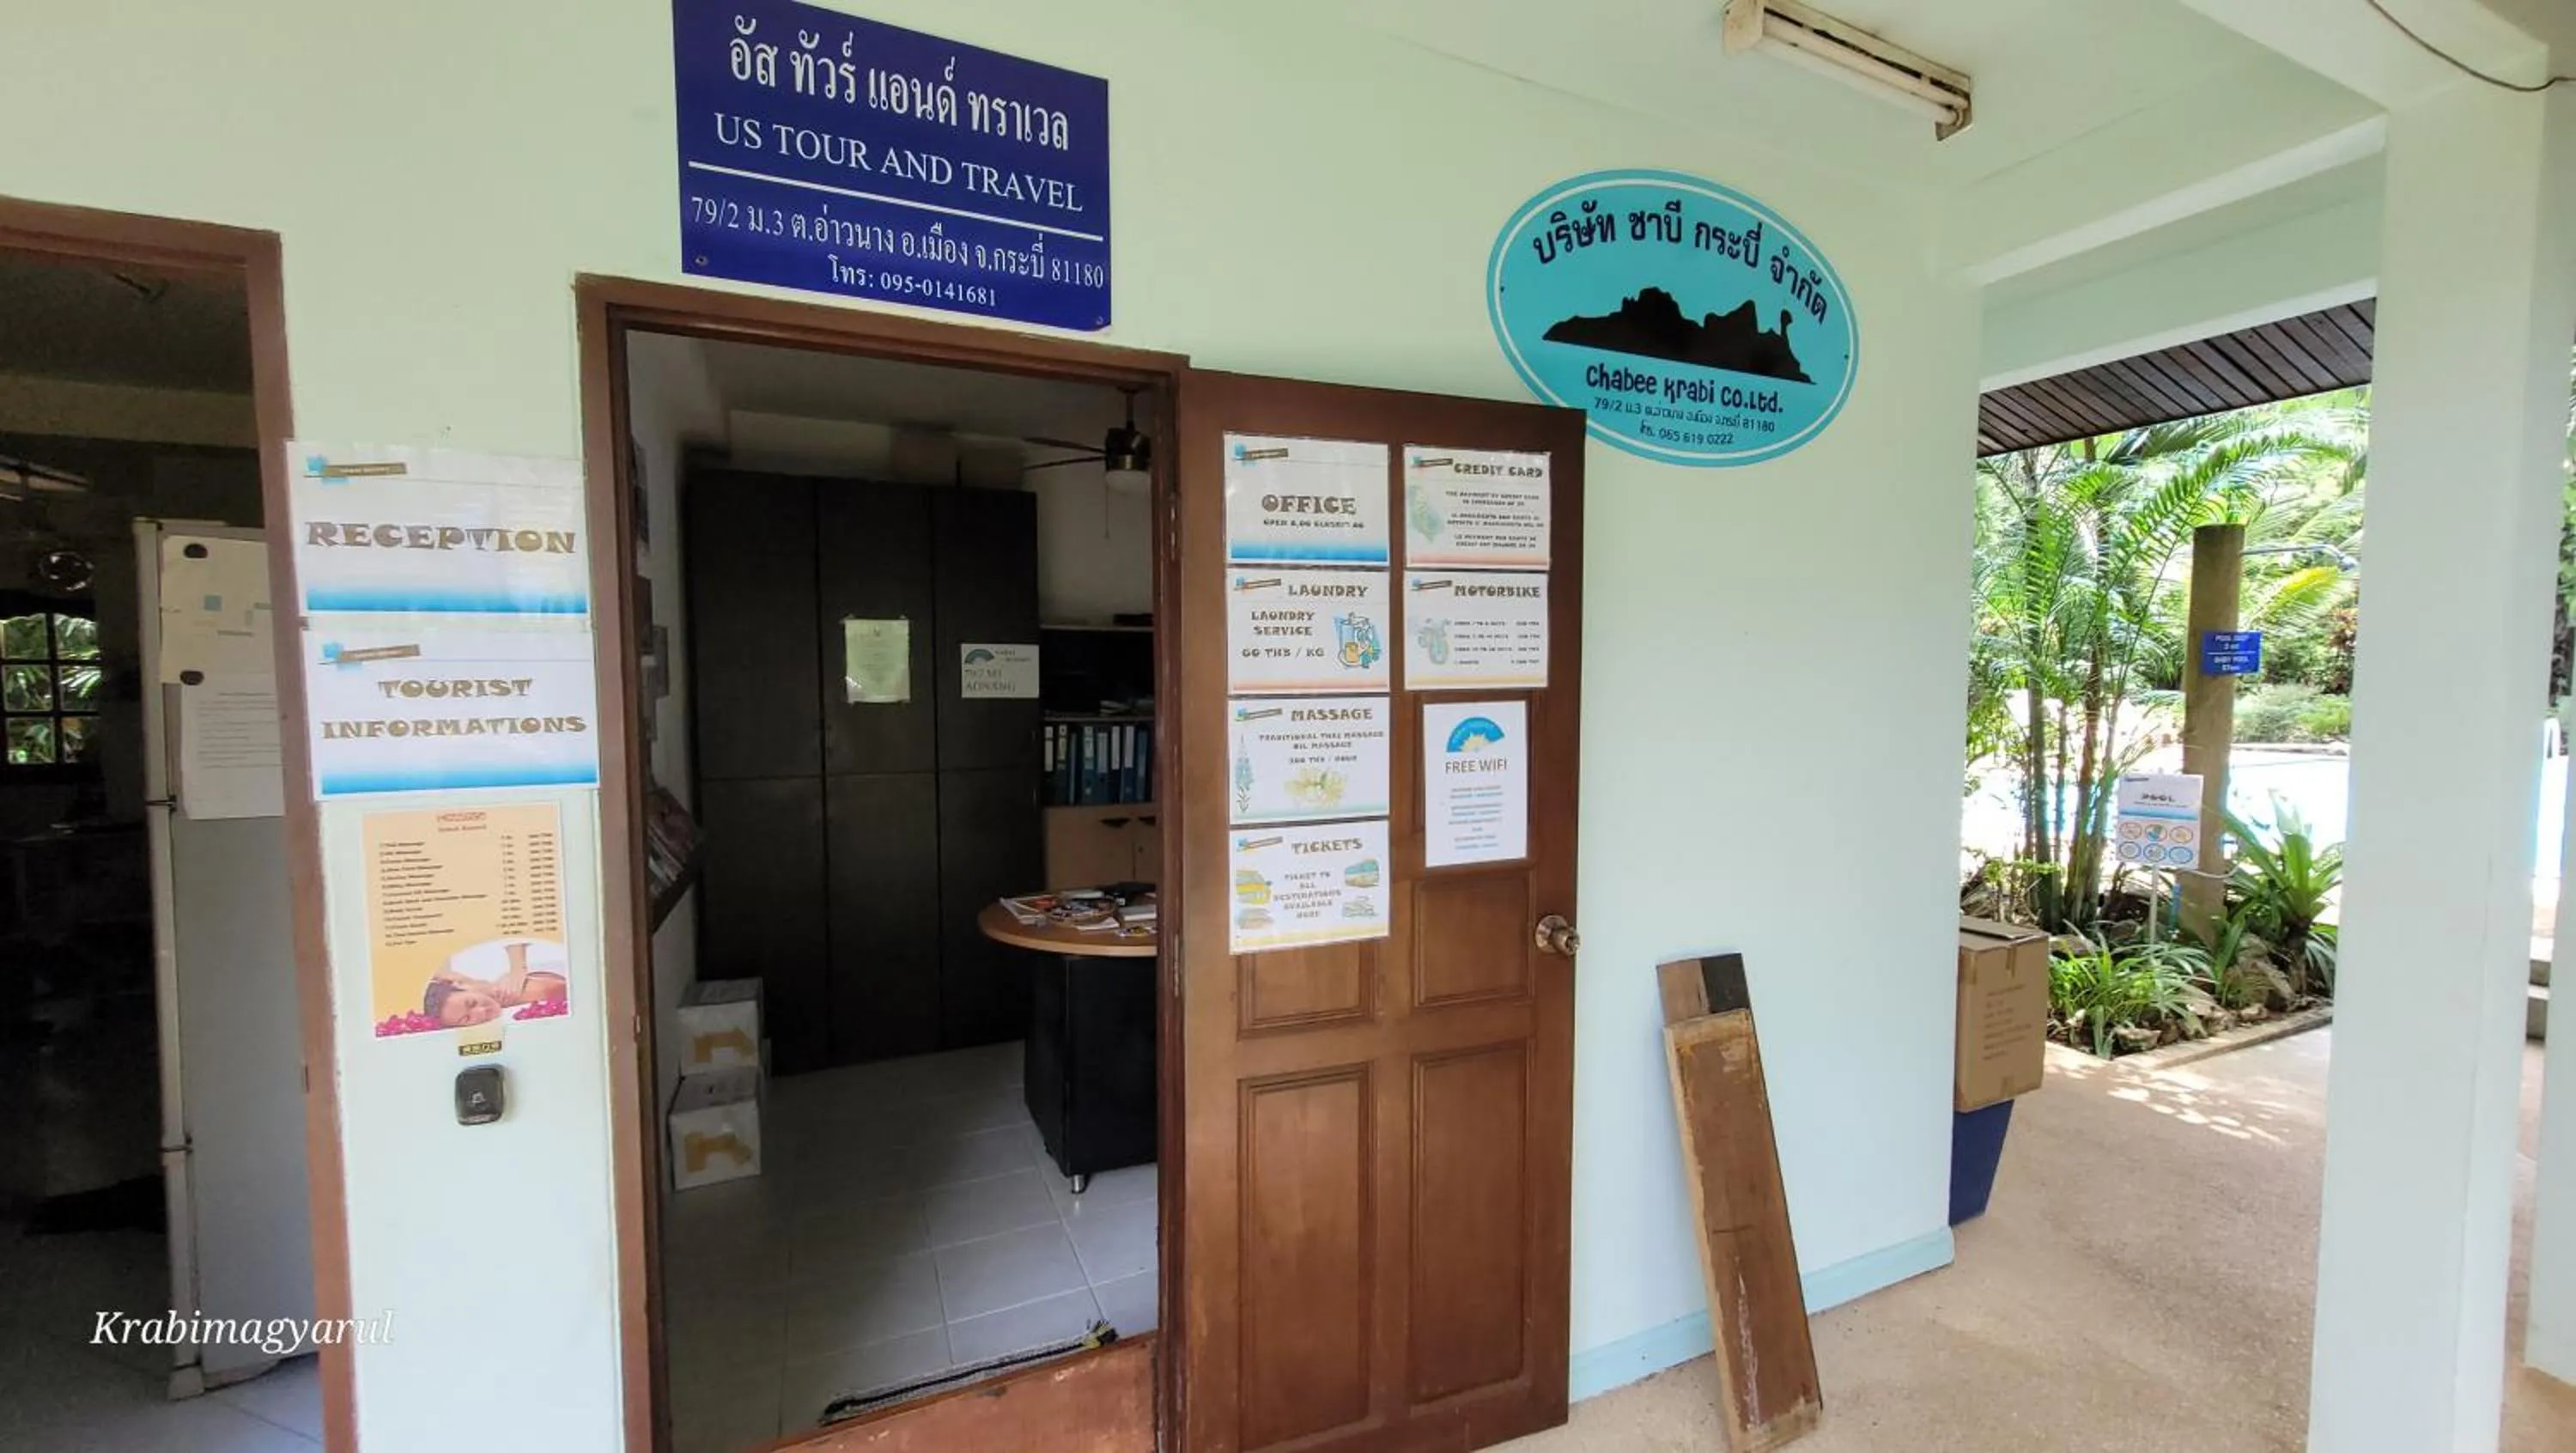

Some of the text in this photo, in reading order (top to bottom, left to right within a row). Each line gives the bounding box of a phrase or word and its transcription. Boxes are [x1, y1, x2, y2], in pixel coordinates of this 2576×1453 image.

[729, 15, 1069, 150] อัส ทัวร์ แอนด์ ทราเวล
[714, 112, 1083, 213] US TOUR AND TRAVEL
[691, 196, 1103, 289] 79/2 ม.3 ต.อ่าวนาง อ.เมือง จ.กระบี่ 81180
[1533, 200, 1828, 325] บริษัท ชาบี กระบี่ จำกัด
[880, 273, 995, 307] 095-0141681
[1594, 397, 1622, 413] 79/2
[1454, 463, 1543, 478] CREDIT CARD
[1261, 494, 1357, 515] OFFICE
[305, 521, 576, 554] RECEPTION
[1288, 584, 1369, 598] LAUNDRY
[1454, 585, 1540, 599] MOTORBIKE
[1251, 611, 1315, 622] LAUNDRY
[1253, 625, 1313, 636] SERVICE
[378, 678, 533, 699] TOURIST
[1291, 708, 1373, 722] MASSAGE
[321, 715, 587, 740] INFORMATIONS
[1445, 758, 1507, 774] FREE WIFI
[1291, 837, 1363, 854] TICKETS
